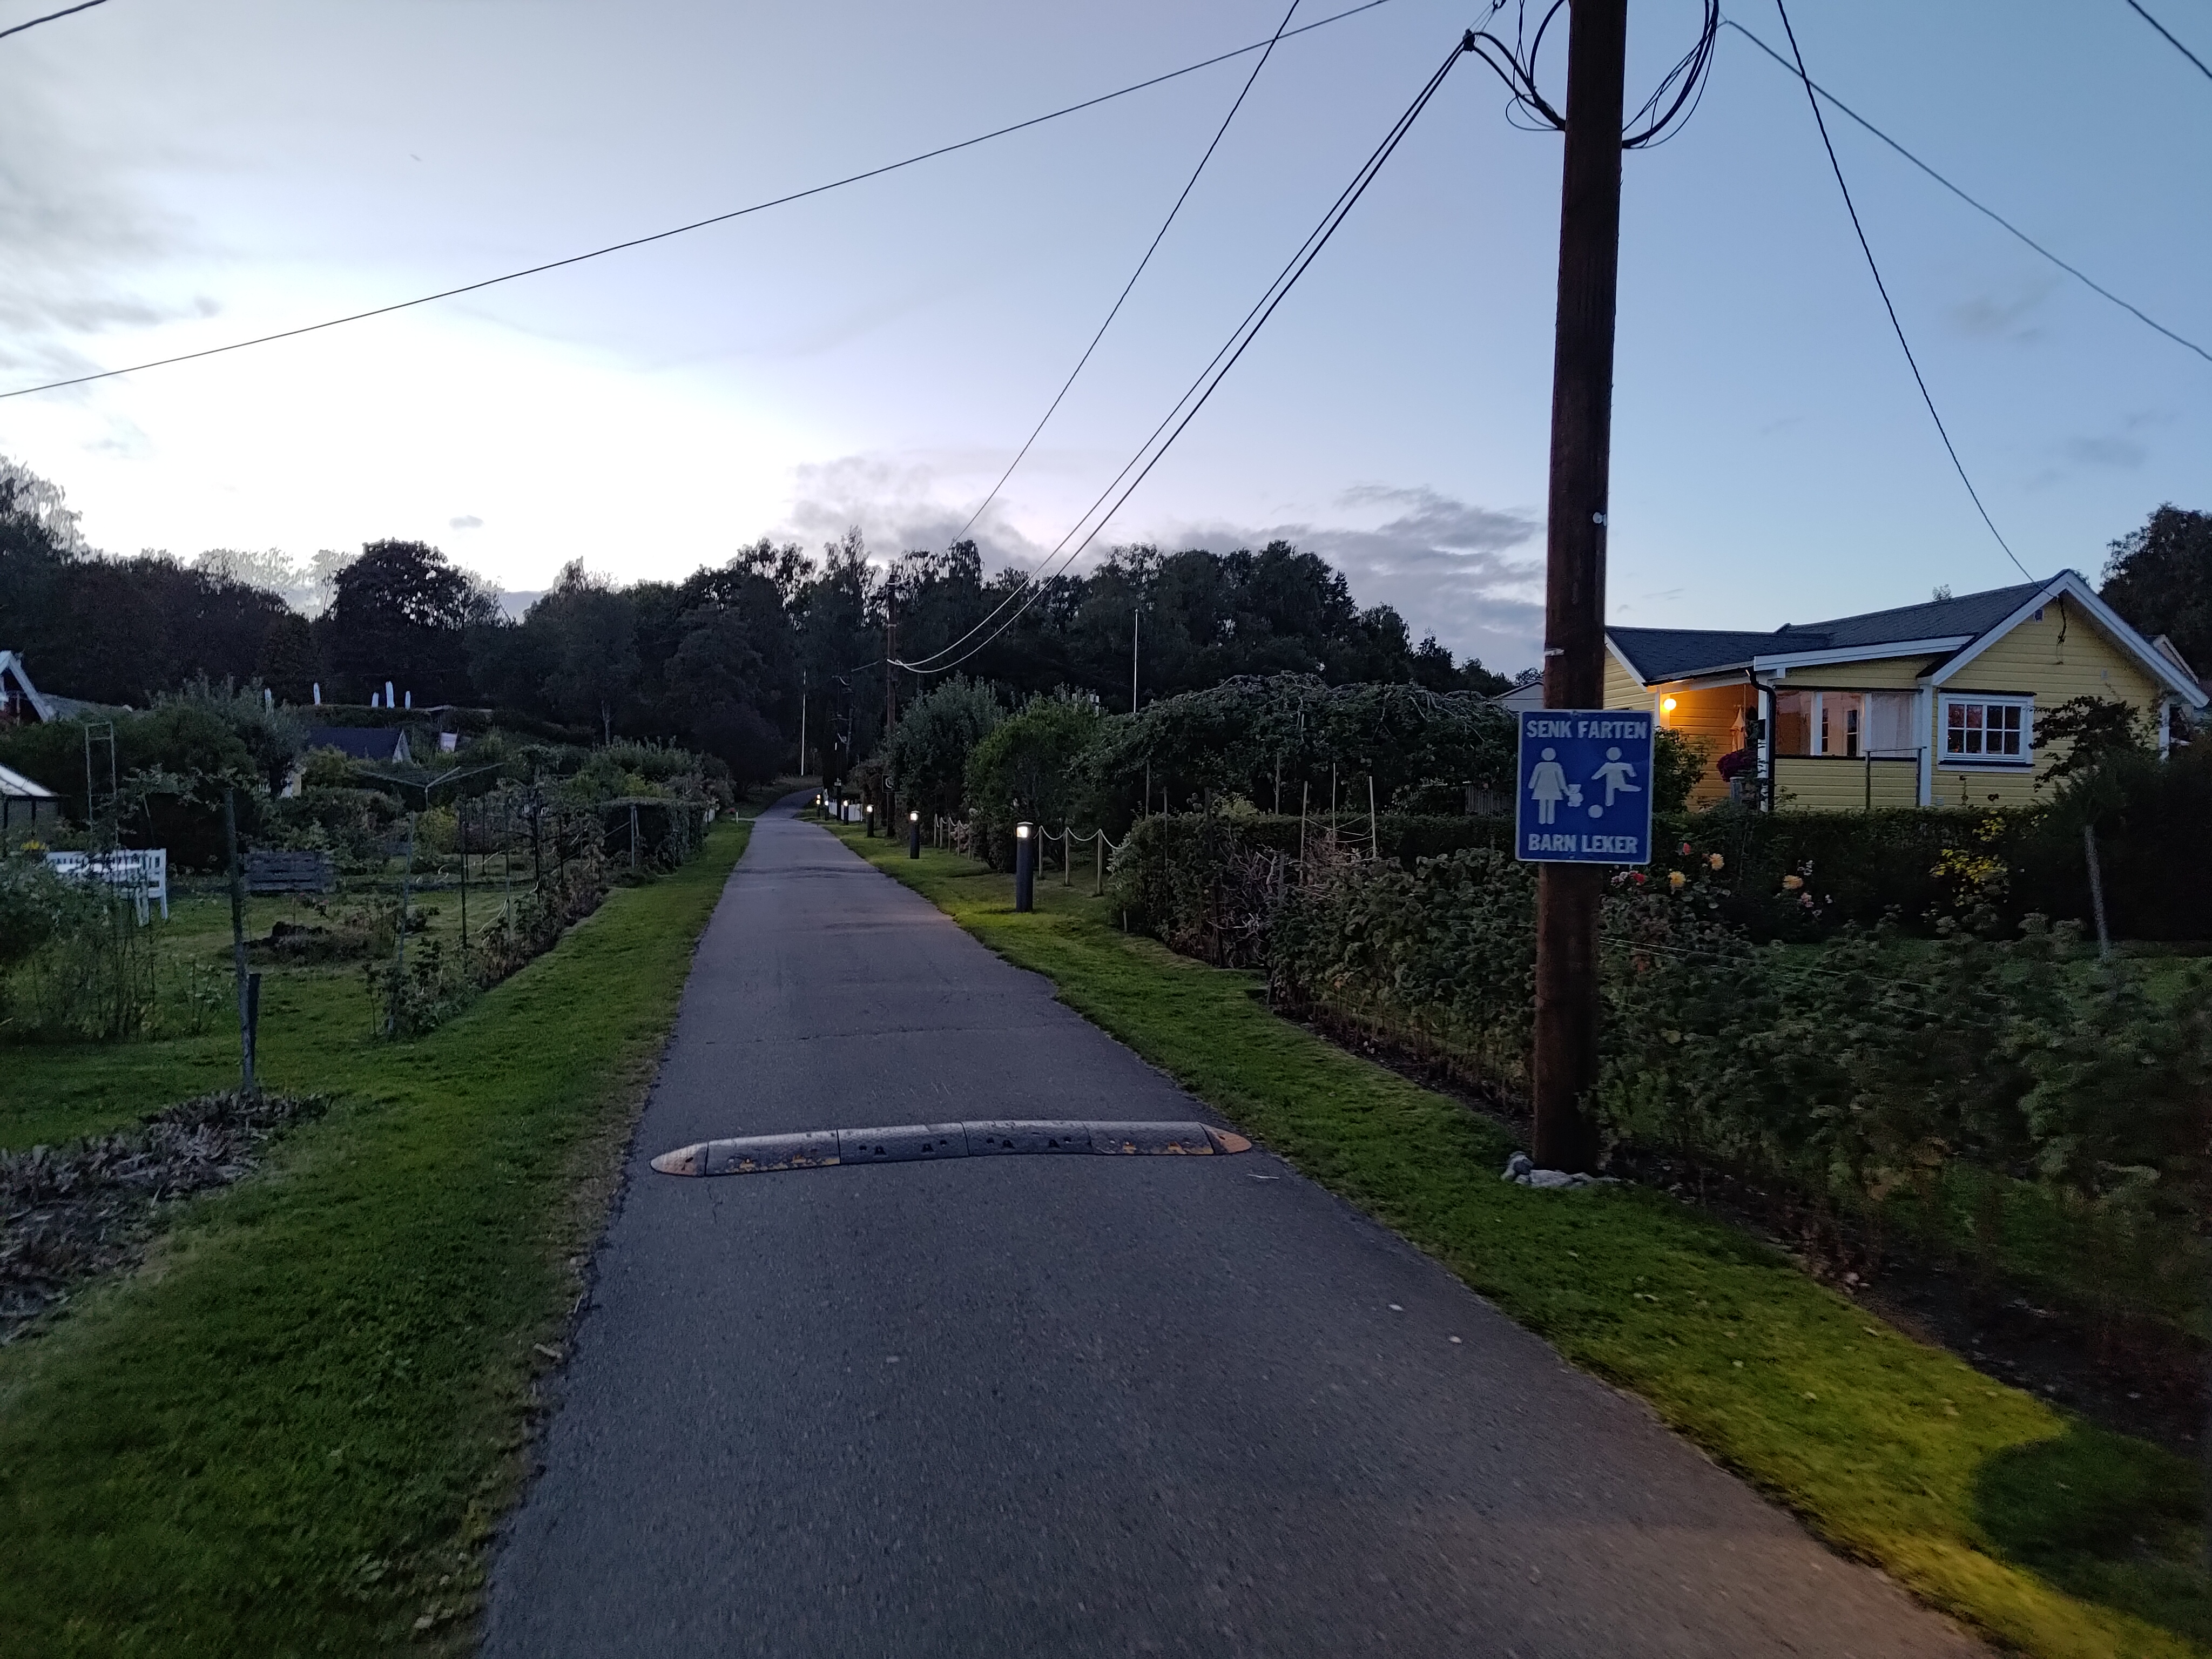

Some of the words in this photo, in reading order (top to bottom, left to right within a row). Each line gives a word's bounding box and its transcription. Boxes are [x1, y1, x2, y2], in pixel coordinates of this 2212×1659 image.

[1526, 720, 1572, 738] SENK
[1577, 721, 1647, 739] FARTEN
[1528, 833, 1577, 852] BARN
[1581, 835, 1638, 853] LEKER
